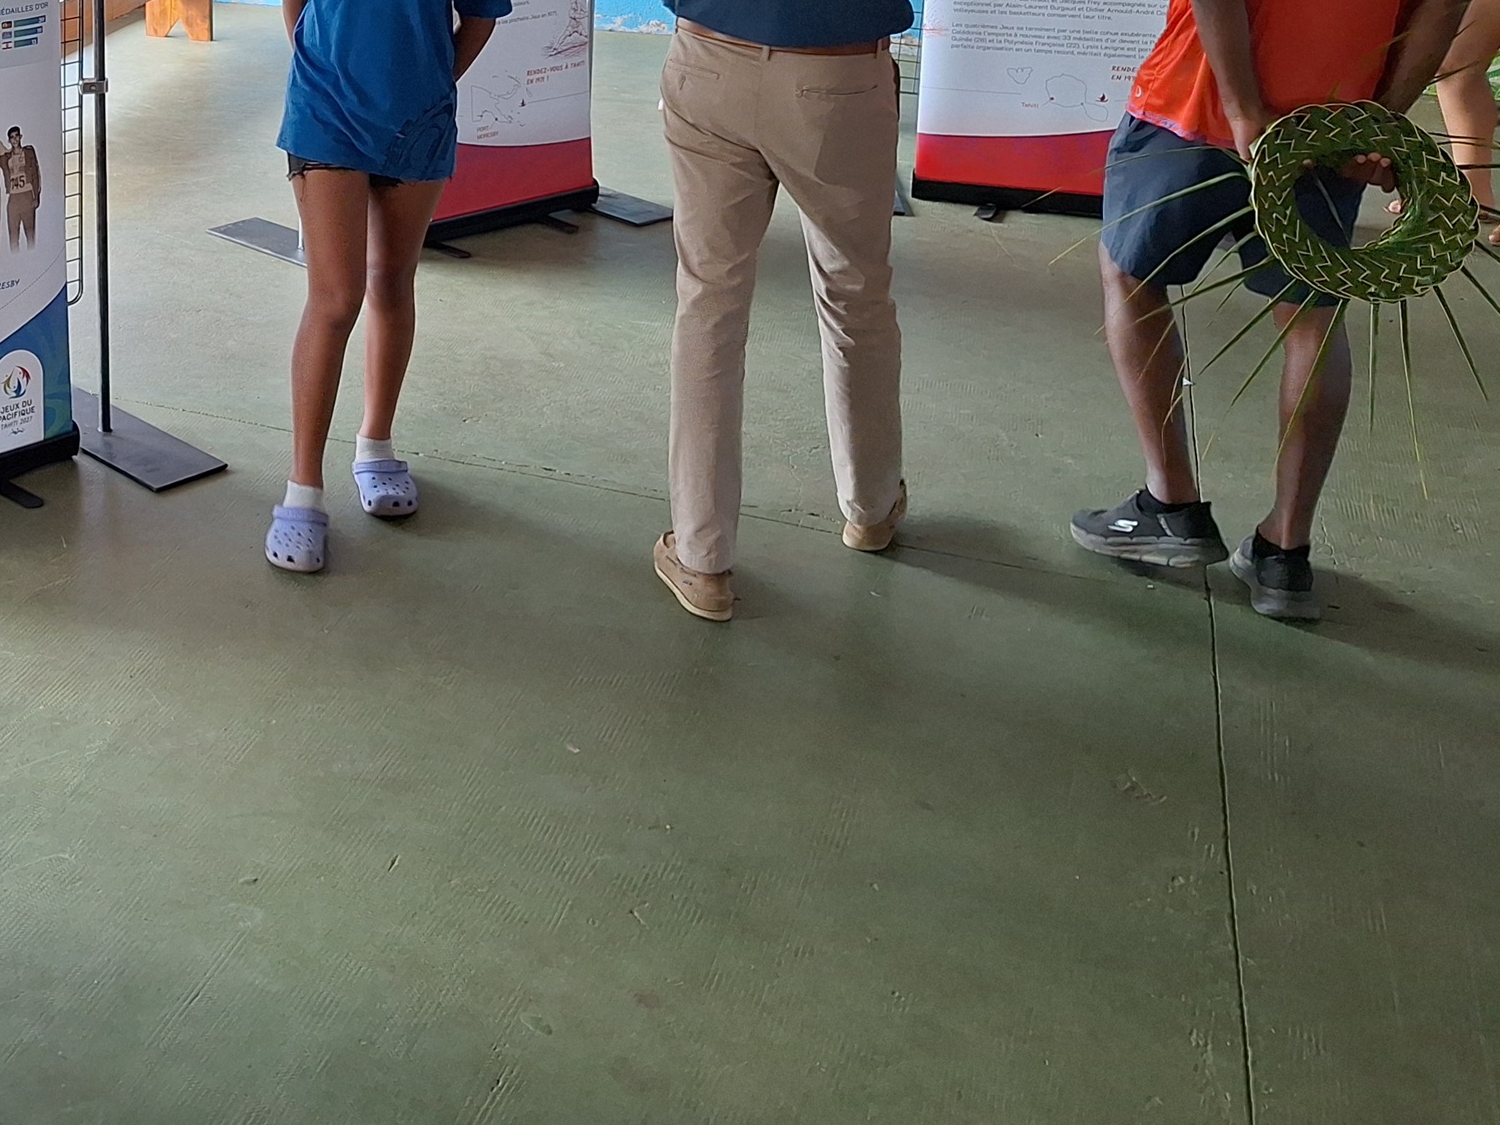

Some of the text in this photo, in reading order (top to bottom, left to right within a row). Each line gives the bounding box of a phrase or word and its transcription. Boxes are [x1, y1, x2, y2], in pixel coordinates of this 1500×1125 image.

[526, 66, 563, 76] RENDEZ-VOUS
[0, 399, 33, 414] JEUX DU
